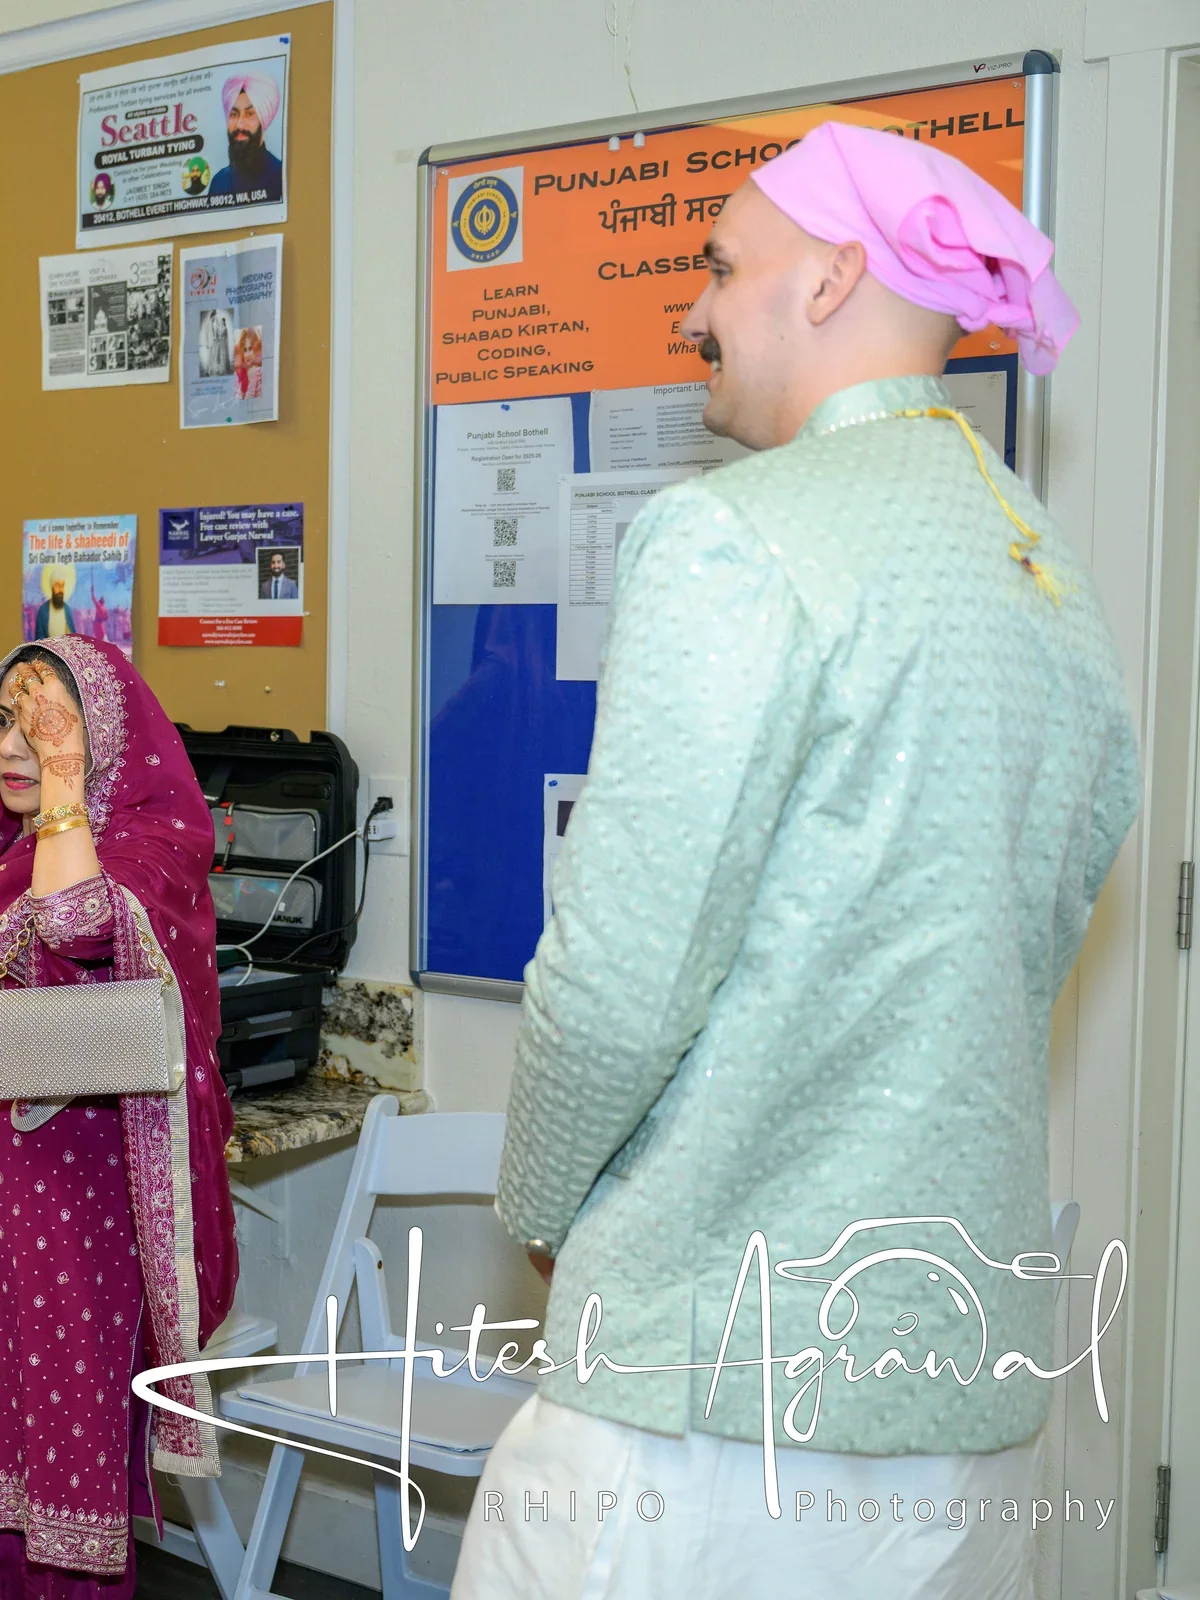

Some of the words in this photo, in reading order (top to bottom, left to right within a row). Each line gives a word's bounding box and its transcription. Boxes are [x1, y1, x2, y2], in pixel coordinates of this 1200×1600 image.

[986, 61, 1013, 71] VIZ-PRO
[120, 99, 138, 108] Turban
[154, 93, 177, 101] services
[101, 102, 198, 148] Seattle
[102, 152, 129, 166] ROYAL
[129, 144, 166, 160] TURBAN
[167, 139, 197, 153] TYING
[534, 160, 669, 196] PUNJABI
[686, 139, 801, 174] SCHO
[116, 208, 145, 221] BOTHELL
[146, 203, 173, 216] EVERETT
[174, 197, 209, 212] HIGHWAY,
[210, 194, 235, 207] 98012,
[236, 192, 250, 204] WA,
[251, 189, 268, 201] USA
[598, 192, 677, 234] ਪੰਜਾਬੀ
[130, 262, 140, 285] 3
[597, 254, 709, 281] CLASSE
[242, 272, 273, 284] WEDDING
[225, 281, 273, 296] PHOTOGRAPHY
[483, 284, 539, 301] LEARN
[228, 291, 273, 305] VIDEOGRAPHY
[472, 304, 551, 322] PUNJABI,
[664, 302, 695, 313] www
[442, 327, 513, 345] SHABAD
[518, 320, 590, 337] KIRTAN,
[477, 344, 551, 362] CODING,
[436, 369, 498, 385] PUBLIC
[503, 360, 595, 379] SPEAKING
[653, 385, 692, 396] Important
[467, 431, 495, 440] Punjabi
[497, 429, 521, 439] School
[522, 427, 549, 437] Bothell
[471, 454, 500, 462] Registration
[501, 453, 515, 461] Open
[617, 489, 640, 497] BOTHELL
[200, 510, 226, 523] Injured?
[226, 510, 240, 520] You
[241, 510, 256, 521] may
[257, 509, 274, 519] have
[281, 509, 299, 518] case.
[93, 521, 119, 530] Remember
[200, 522, 214, 532] Free
[214, 523, 228, 531] case
[229, 521, 251, 531] review
[252, 520, 269, 530] with
[29, 534, 46, 551] The
[48, 533, 63, 550] life
[65, 533, 72, 549] &
[74, 531, 117, 549] shaheedi
[119, 531, 129, 547] of
[200, 532, 223, 543] Lawyer
[224, 531, 248, 543] Gurjot
[248, 529, 274, 541] Narwal
[28, 553, 38, 564] Sri
[39, 553, 56, 563] Guru
[57, 551, 72, 565] Tegh
[74, 550, 101, 562] Bahadur
[102, 549, 122, 562] Sahib
